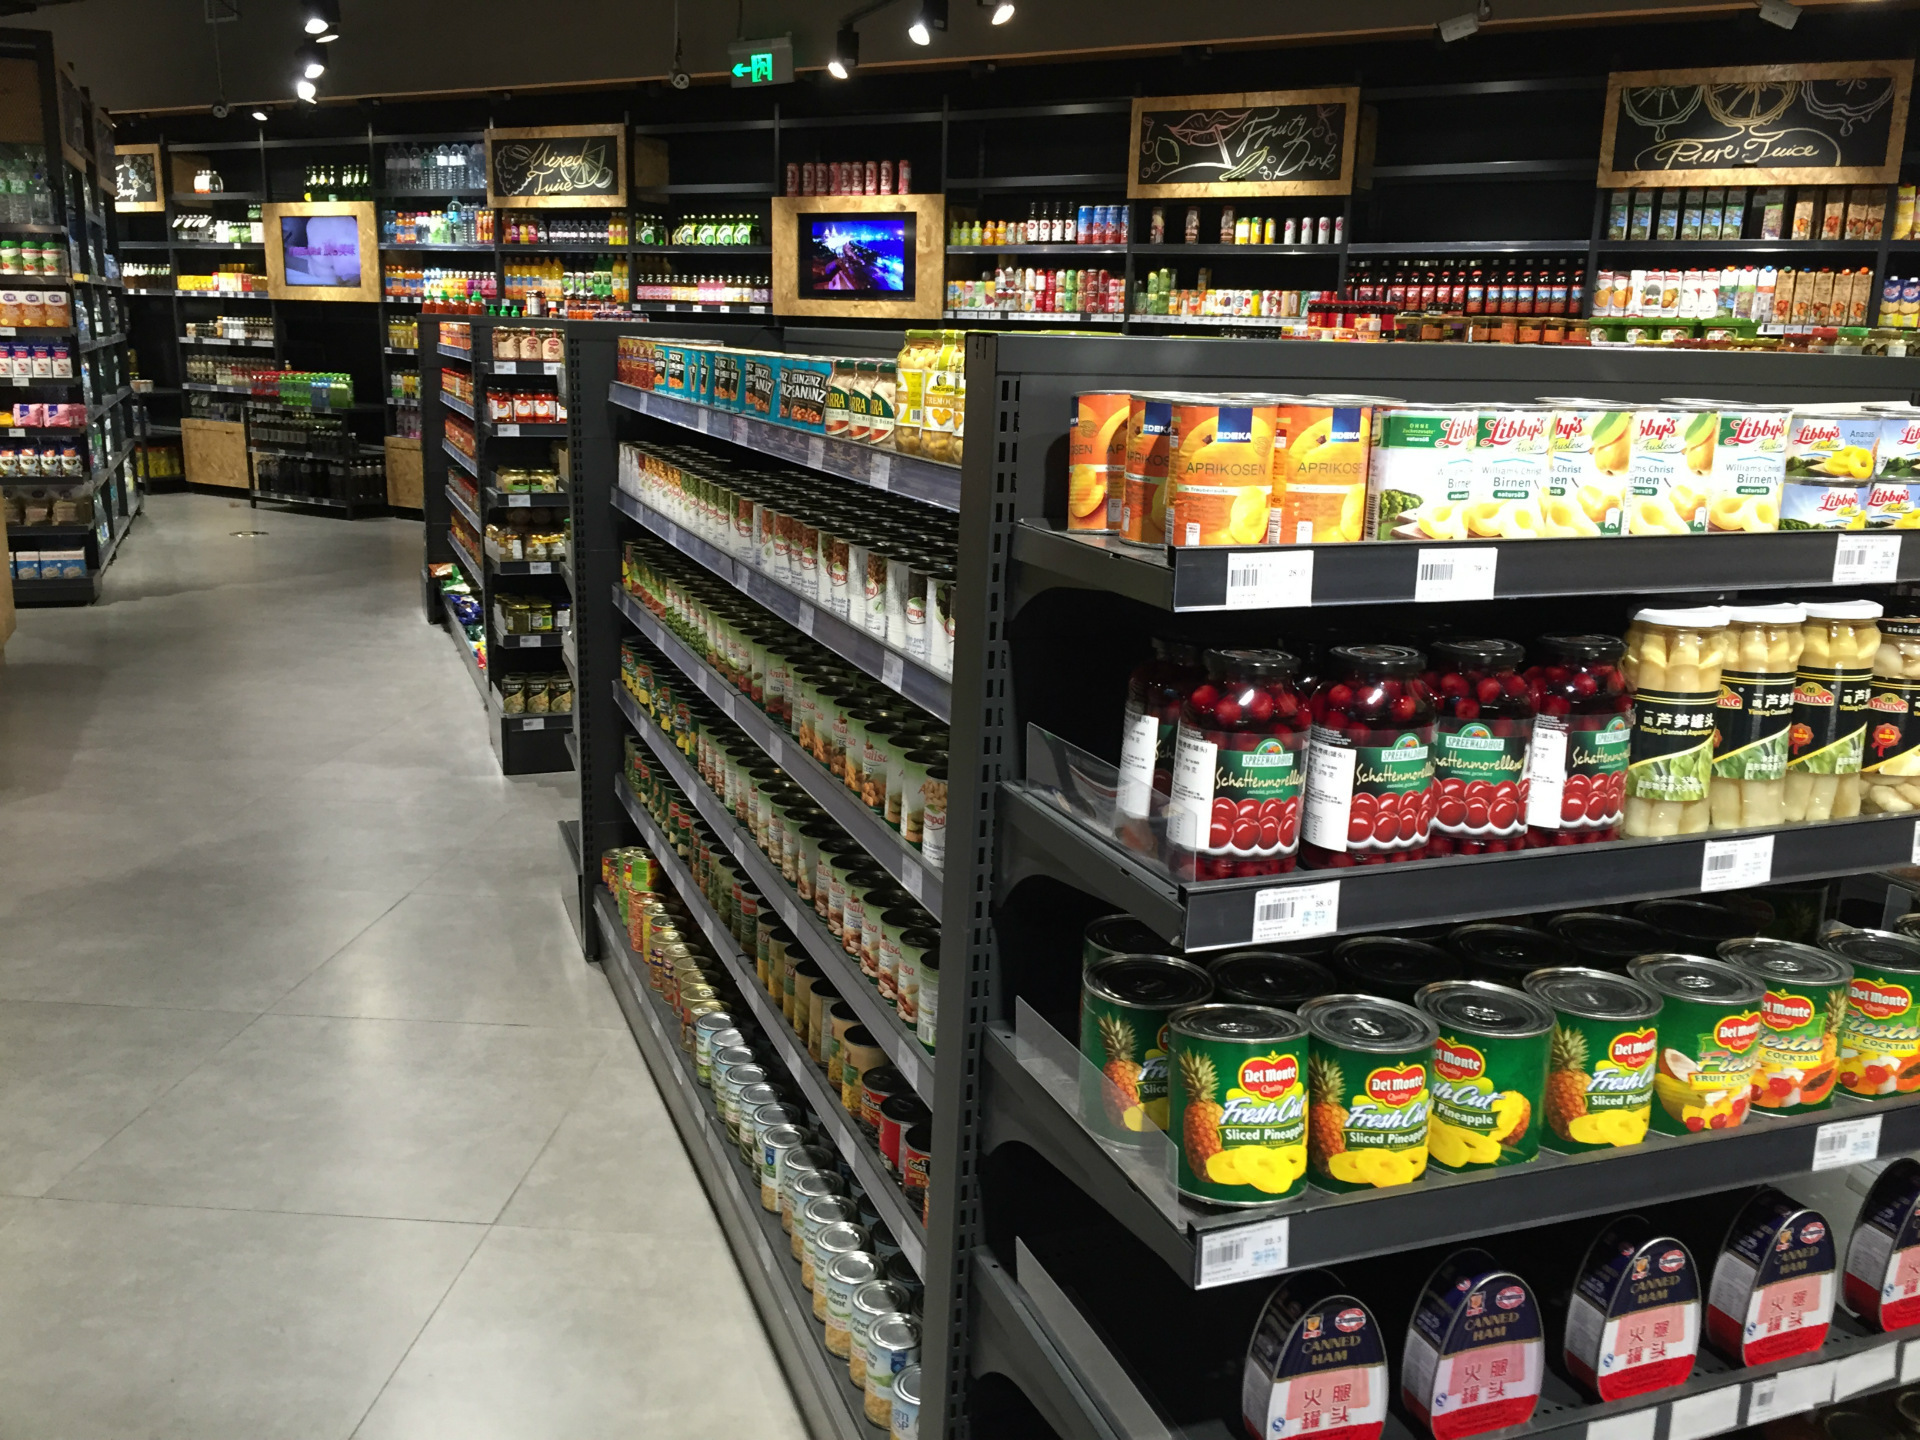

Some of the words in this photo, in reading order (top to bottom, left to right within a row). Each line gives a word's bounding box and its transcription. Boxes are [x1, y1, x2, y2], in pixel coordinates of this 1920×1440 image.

[1236, 107, 1312, 157] Fruity
[529, 139, 589, 168] Mixed
[1742, 131, 1819, 163] Juice
[527, 168, 574, 195] Juice
[1144, 424, 1173, 433] EDEKA
[1217, 431, 1251, 440] EDEKA
[1331, 431, 1360, 440] EDEKA
[1435, 417, 1478, 448] Libb
[1480, 416, 1544, 447] Libby's
[1555, 417, 1583, 439] by's
[1640, 418, 1676, 440] bby's
[1724, 417, 1785, 445] Libby's
[1793, 425, 1840, 445] Libby's
[1128, 451, 1170, 465] APRIKOS
[1186, 462, 1266, 475] APRIKOSEN
[1298, 462, 1363, 474] APRIKOSE
[1557, 465, 1581, 473] Christ
[1649, 465, 1674, 473] Christ
[1493, 477, 1531, 487] Birnen
[1633, 476, 1660, 485] rnen
[1737, 474, 1772, 484] Birnen
[1817, 492, 1858, 512] Libby's
[1868, 488, 1910, 506] Libby's
[1718, 699, 1740, 707] ING
[1793, 694, 1832, 704] YIMING
[1871, 701, 1907, 711] YIMING
[1656, 713, 1714, 729] 芦笋罐头
[1447, 736, 1504, 750] SPREEWALDHOF
[1851, 986, 1868, 1000] Del
[1870, 992, 1908, 1007] Monte
[1773, 1003, 1811, 1018] Monte
[1720, 1026, 1736, 1038] Del
[1614, 1044, 1631, 1055] Del
[1862, 1038, 1916, 1050] COCKTAIL
[1443, 1051, 1480, 1070] Monte
[1765, 1050, 1819, 1062] COCKTAIL
[1245, 1071, 1263, 1082] Del
[1265, 1067, 1296, 1082] Monte
[1587, 1068, 1644, 1092] Fresh
[1143, 1085, 1168, 1094] Slice
[1261, 1084, 1284, 1093] Quality
[1372, 1080, 1390, 1091] Del
[1393, 1076, 1423, 1090] Monte
[1387, 1093, 1409, 1101] Quality
[1452, 1086, 1506, 1109] Cut
[1592, 1095, 1624, 1105] Sliced
[1220, 1097, 1276, 1125] Fresh
[1277, 1094, 1307, 1122] Cut
[1345, 1104, 1401, 1128] Fresh
[1438, 1104, 1493, 1125] Pineapple
[1226, 1129, 1259, 1140] Sliced
[1350, 1132, 1384, 1144] Sliced
[1630, 1275, 1681, 1294] CANNED
[1638, 1289, 1668, 1303] HAM
[1464, 1312, 1520, 1330] CANNED
[1473, 1326, 1507, 1341] HAM
[1302, 1336, 1362, 1354] CANNED
[1311, 1350, 1347, 1365] HAM
